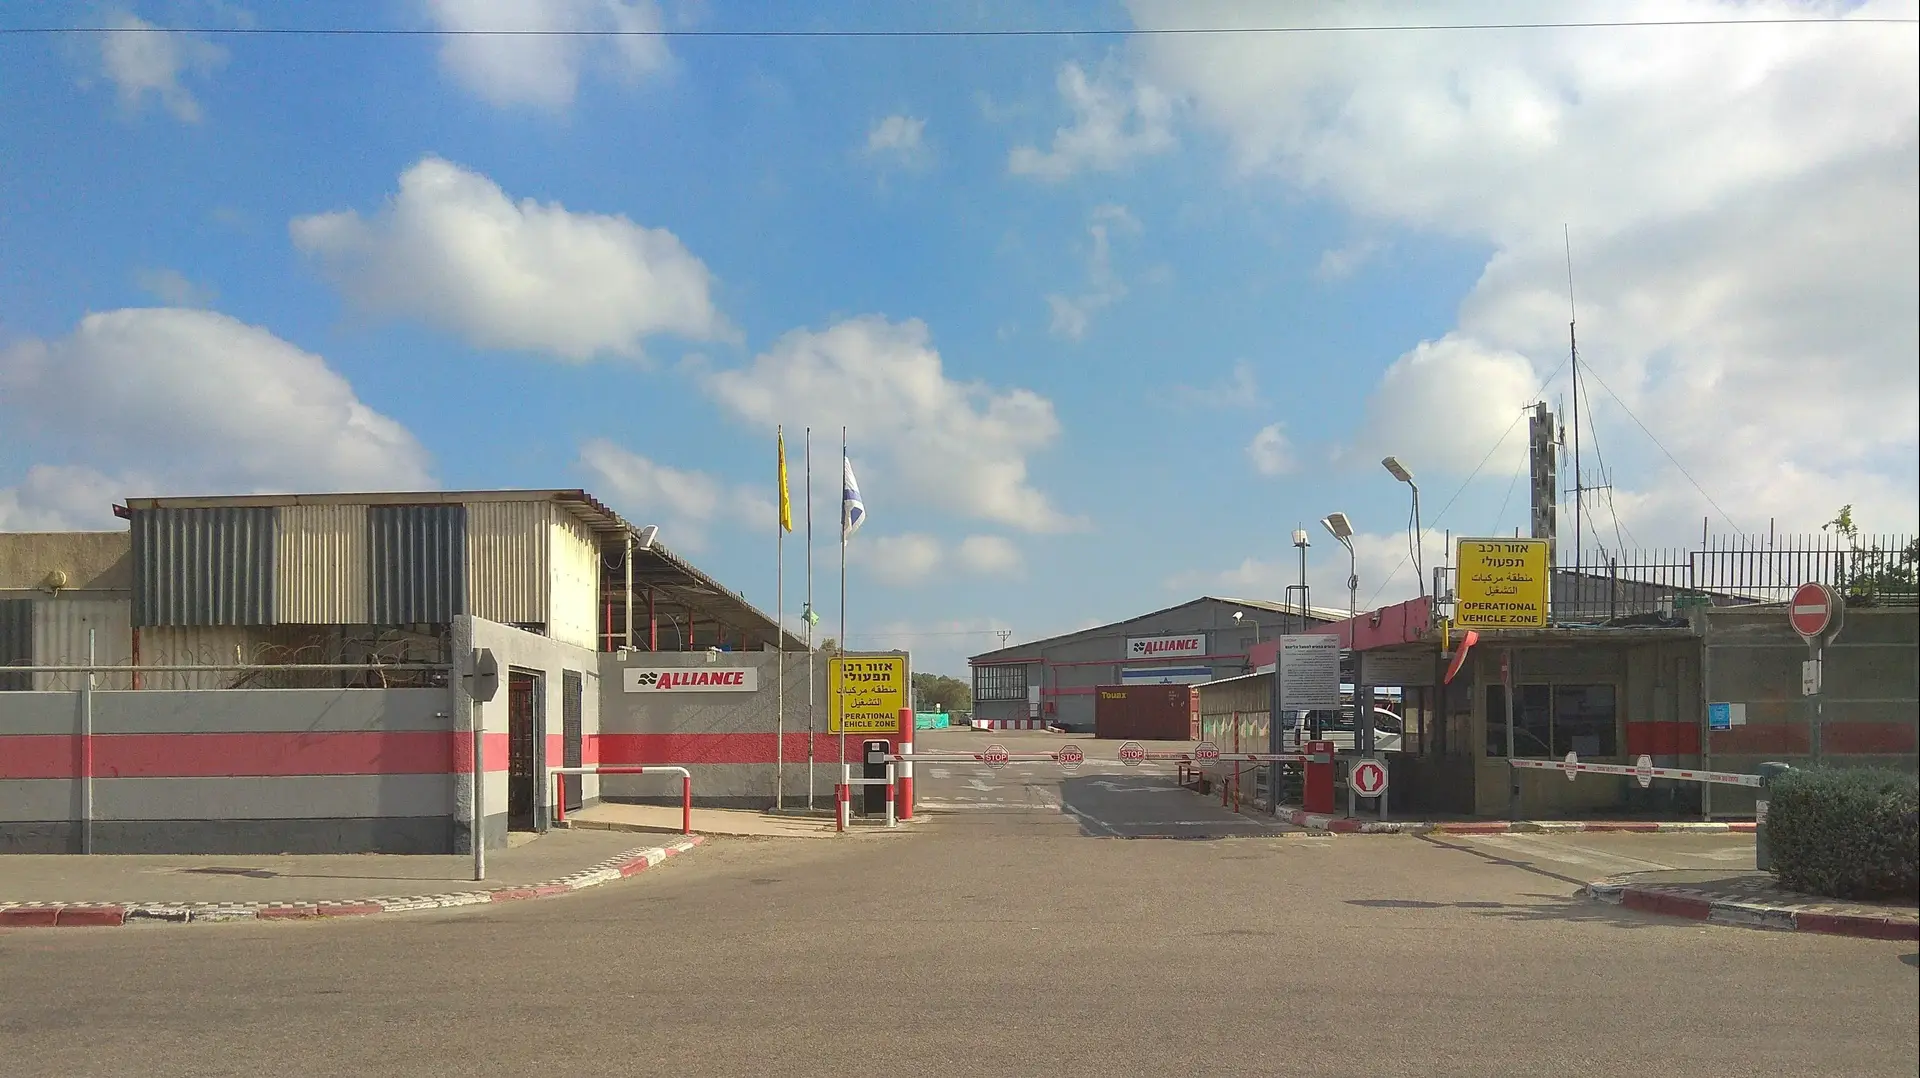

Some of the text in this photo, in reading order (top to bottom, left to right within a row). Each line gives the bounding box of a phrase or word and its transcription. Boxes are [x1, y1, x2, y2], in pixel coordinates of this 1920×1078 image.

[1479, 544, 1529, 553] אזור רכב
[1481, 556, 1524, 568] תפעולי
[1471, 572, 1533, 584] منطقة مركبات
[1485, 586, 1518, 597] التشغيل
[1464, 602, 1537, 611] OPERATIONAL
[1462, 614, 1538, 623] VEHICLE ZONE
[1143, 639, 1199, 655] ALLIANCE
[866, 663, 893, 672] אזור
[655, 671, 745, 690] ALLIANCE
[844, 672, 890, 682] תפעולי
[850, 698, 882, 708] التشغيل
[841, 720, 896, 728] EHICLE ZONE
